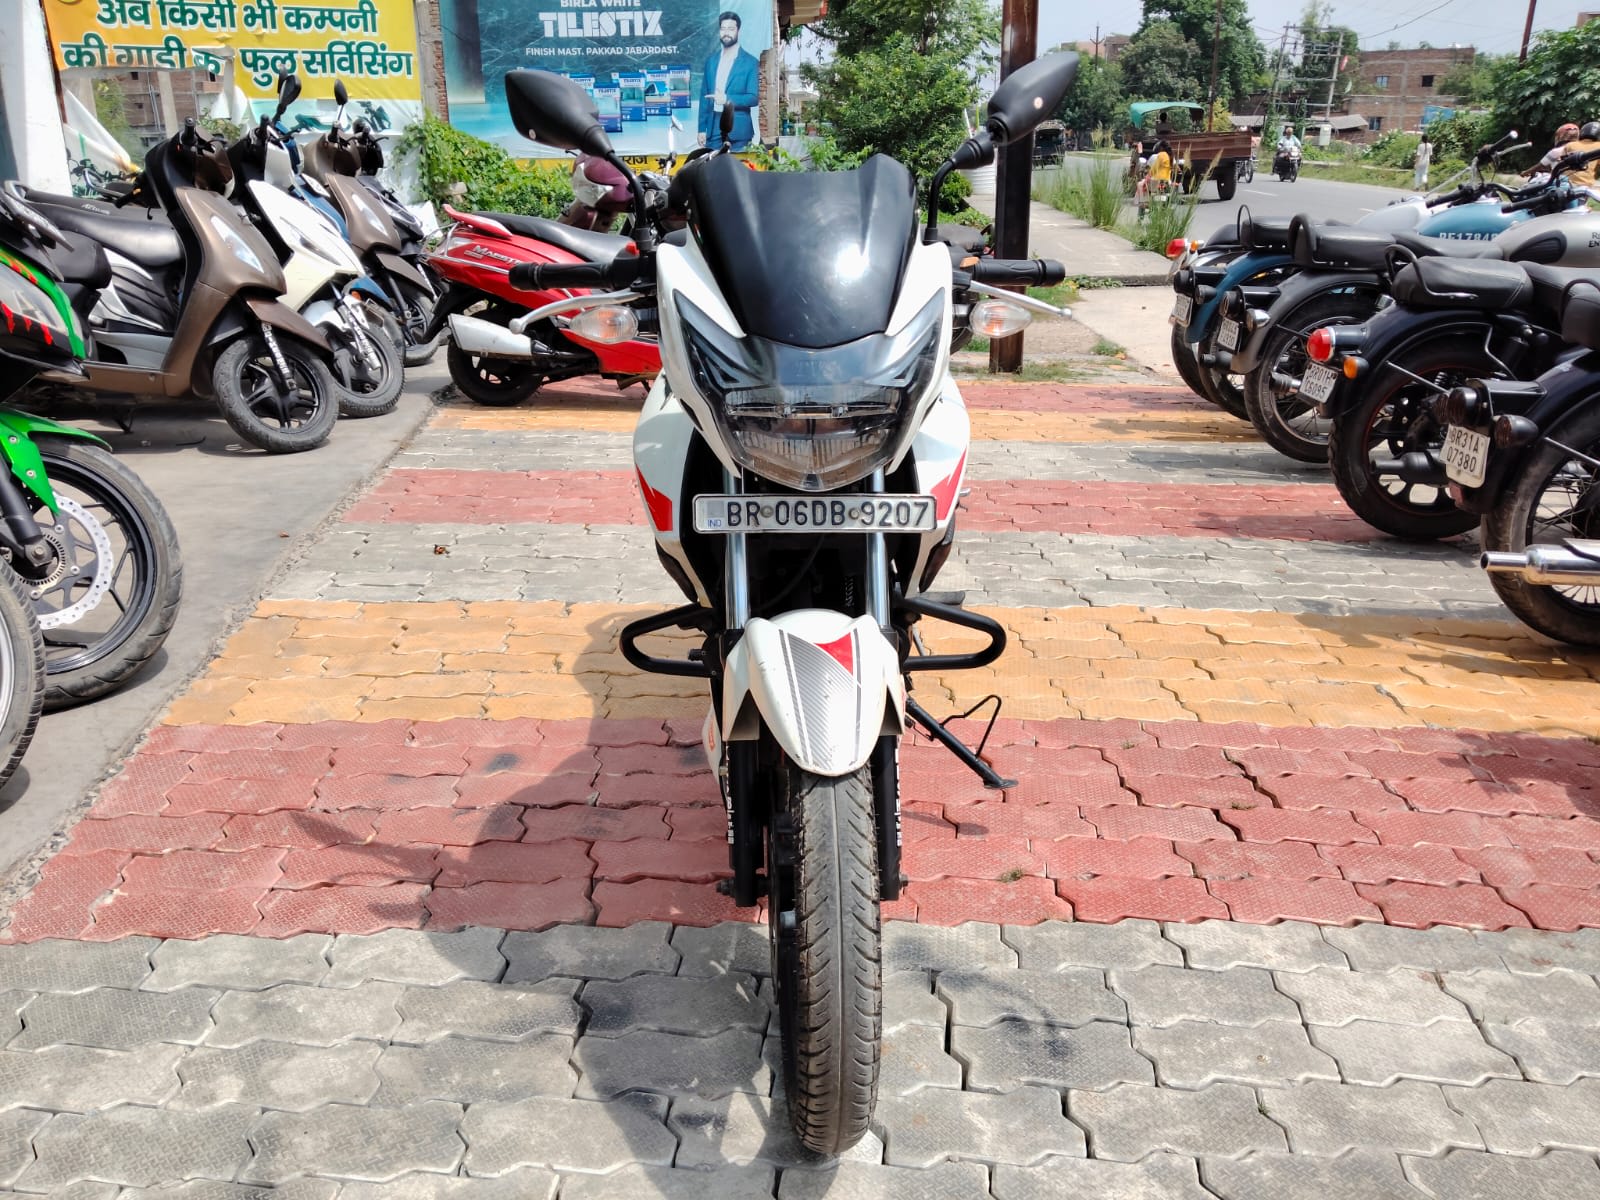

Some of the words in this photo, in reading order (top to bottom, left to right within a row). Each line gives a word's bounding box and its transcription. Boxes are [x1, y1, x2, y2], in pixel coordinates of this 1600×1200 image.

[97, 0, 150, 25] अब
[157, 0, 236, 28] किसी
[242, 0, 277, 30] भी
[282, 0, 378, 33] कम्पनी
[561, 0, 597, 8] BIRLA
[538, 11, 664, 38] TILESTIX
[60, 33, 108, 67] की
[239, 49, 299, 87] फुल
[525, 47, 555, 56] FINISH
[558, 47, 584, 56] MAST.
[586, 46, 623, 55] PAKKAD
[625, 45, 680, 55] JABARDAST.
[1449, 427, 1480, 454] BR31A
[727, 501, 762, 527] BR
[860, 501, 929, 527] 9207
